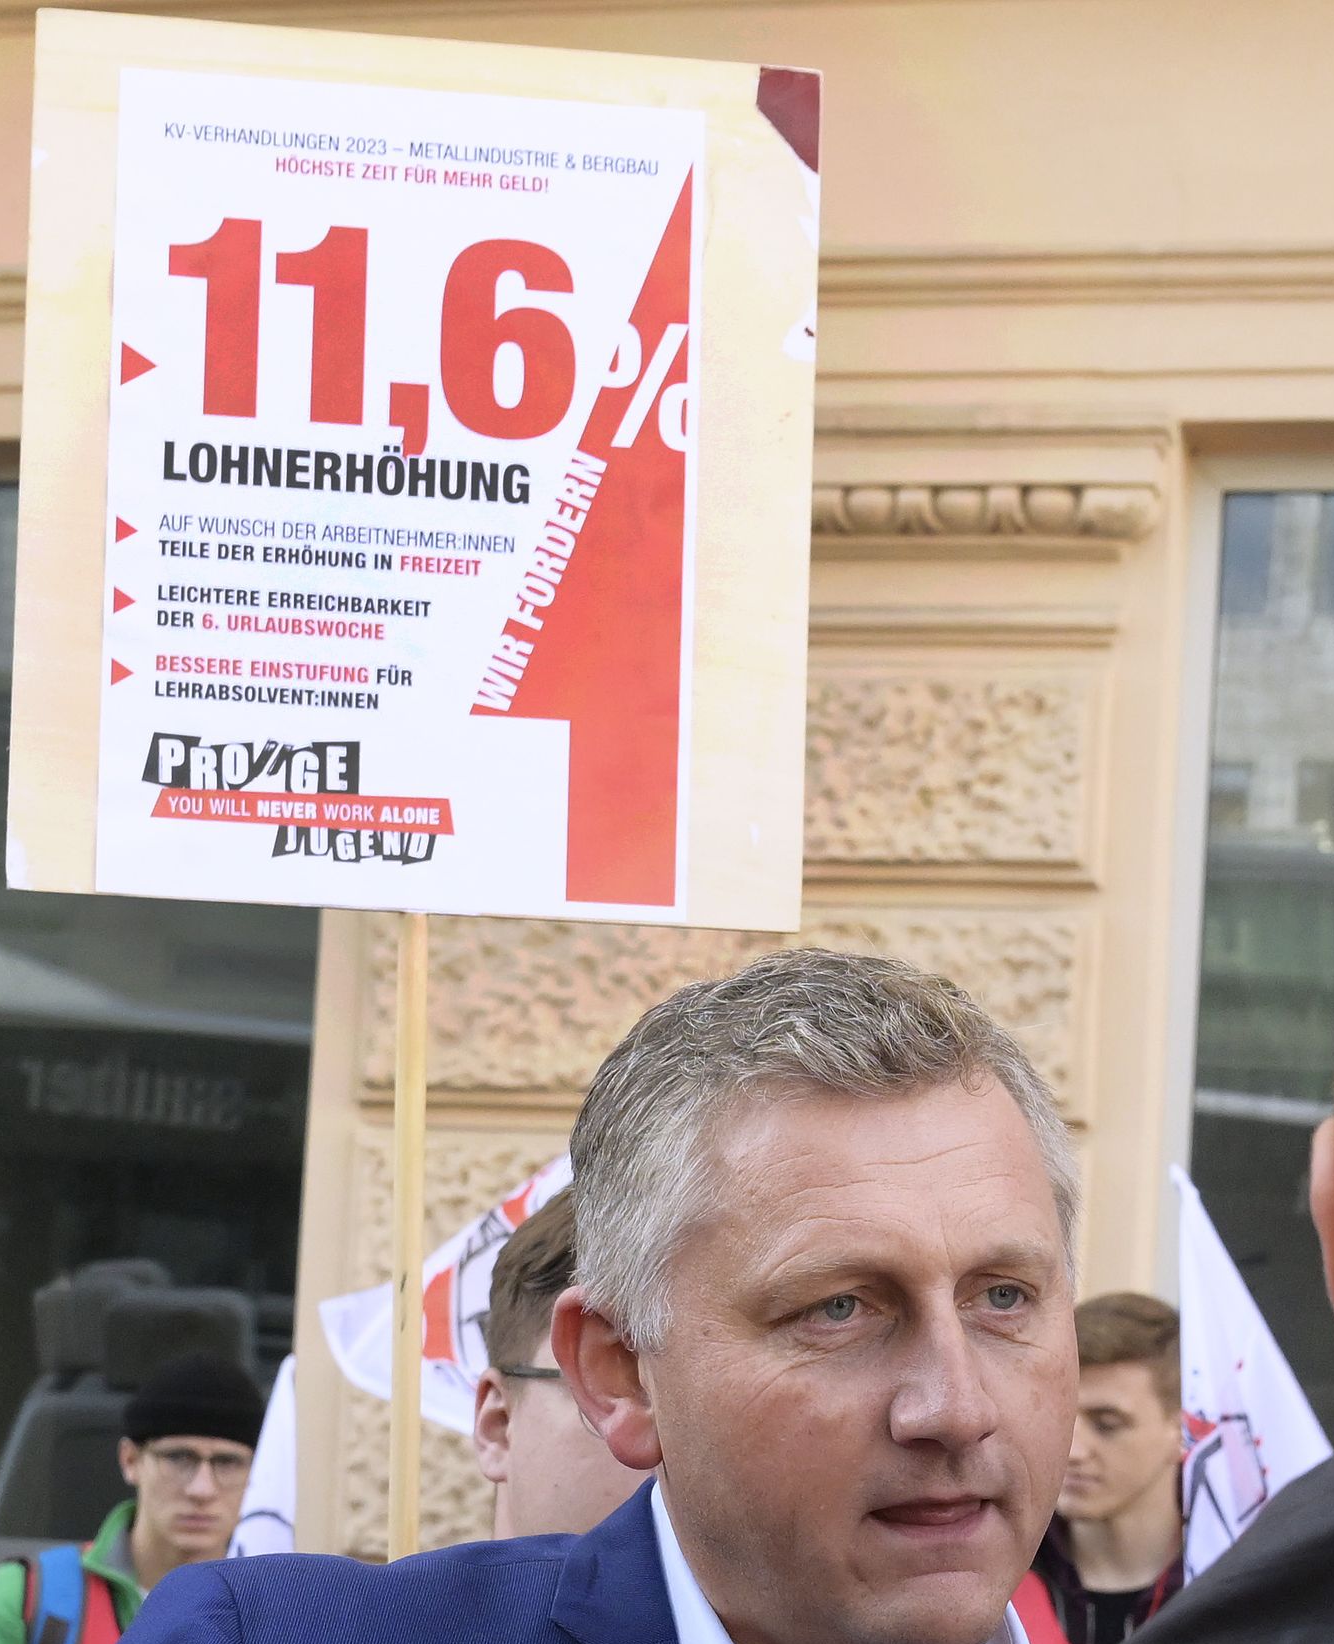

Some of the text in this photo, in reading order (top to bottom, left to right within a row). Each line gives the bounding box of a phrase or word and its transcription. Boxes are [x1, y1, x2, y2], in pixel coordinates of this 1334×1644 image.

[165, 123, 339, 151] KV-VERHANDLUNGEN
[347, 137, 386, 154] 2023
[409, 142, 559, 168] METALLINDUSTRIE
[566, 154, 575, 168] &
[583, 155, 658, 175] BERGBAU
[276, 157, 548, 192] HÖCHSTE ZEIT FÜR MEHR GELD!
[162, 441, 531, 505] LOHNERHÖHUNG
[159, 514, 514, 553] AUF WUNSCH DER ARBEITNEHMER:INNEN
[159, 539, 481, 576] TEILE DER ERHÖHUNG IN FREIZEIT
[472, 449, 608, 712] WIR FORDERN
[158, 584, 431, 618] LEICHTERE ERREICHBARKEIT
[157, 610, 384, 640] DER 6. URLAUBSWOCHE
[156, 655, 412, 686] BESSERE EINSTUFUNG FÜR
[155, 680, 378, 710] LEHRABSOLVENT:INNEN
[168, 796, 440, 825] YOU WILL NEVER WORK ALONE
[285, 825, 432, 861] JUGEND
